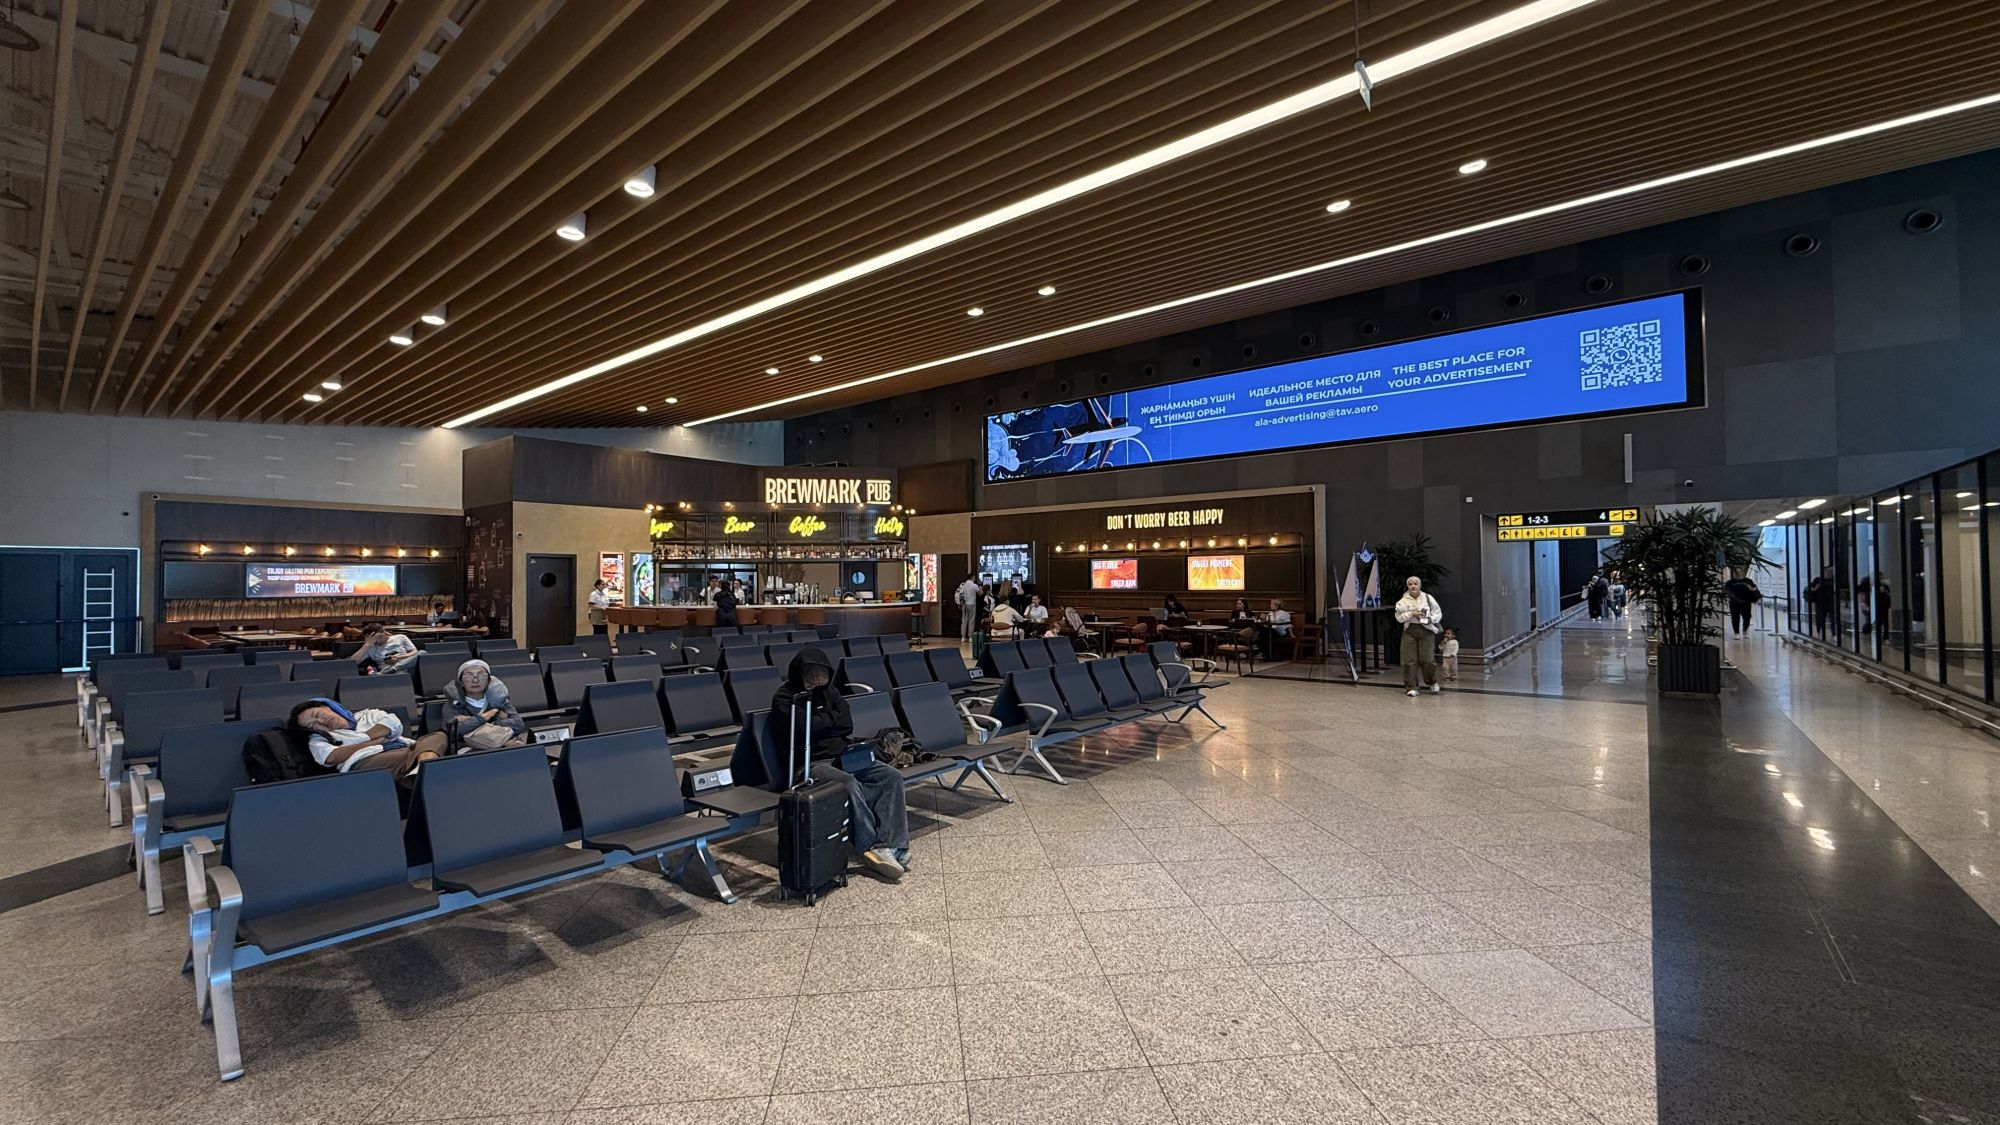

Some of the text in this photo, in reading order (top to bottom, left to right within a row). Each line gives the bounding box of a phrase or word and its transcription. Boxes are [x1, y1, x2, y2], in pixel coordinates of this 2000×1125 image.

[1392, 347, 1525, 375] THE BEST PLACE FOR
[1250, 369, 1381, 397] ИДЕАЛЬНОЕ МЕСТО ДЛЯ
[1388, 359, 1533, 389] YOUR ADVERTISEMENT
[1141, 397, 1208, 414] ЖАРНАМАҢЫЗ
[1265, 385, 1363, 407] ВАШЕЙ РЕКЛАМЫ
[1197, 406, 1226, 417] ОРЫН
[1254, 403, 1379, 427] ala-advertising@tav.aero
[765, 478, 891, 504] BREWMARK PUB
[724, 516, 755, 534] Beer
[789, 515, 827, 537] Coffee
[1107, 508, 1224, 530] DON'T WORRY BEER HAPPY
[1527, 516, 1549, 524] 1-2-3
[1599, 512, 1606, 520] 4
[294, 583, 341, 594] BREWMARK
